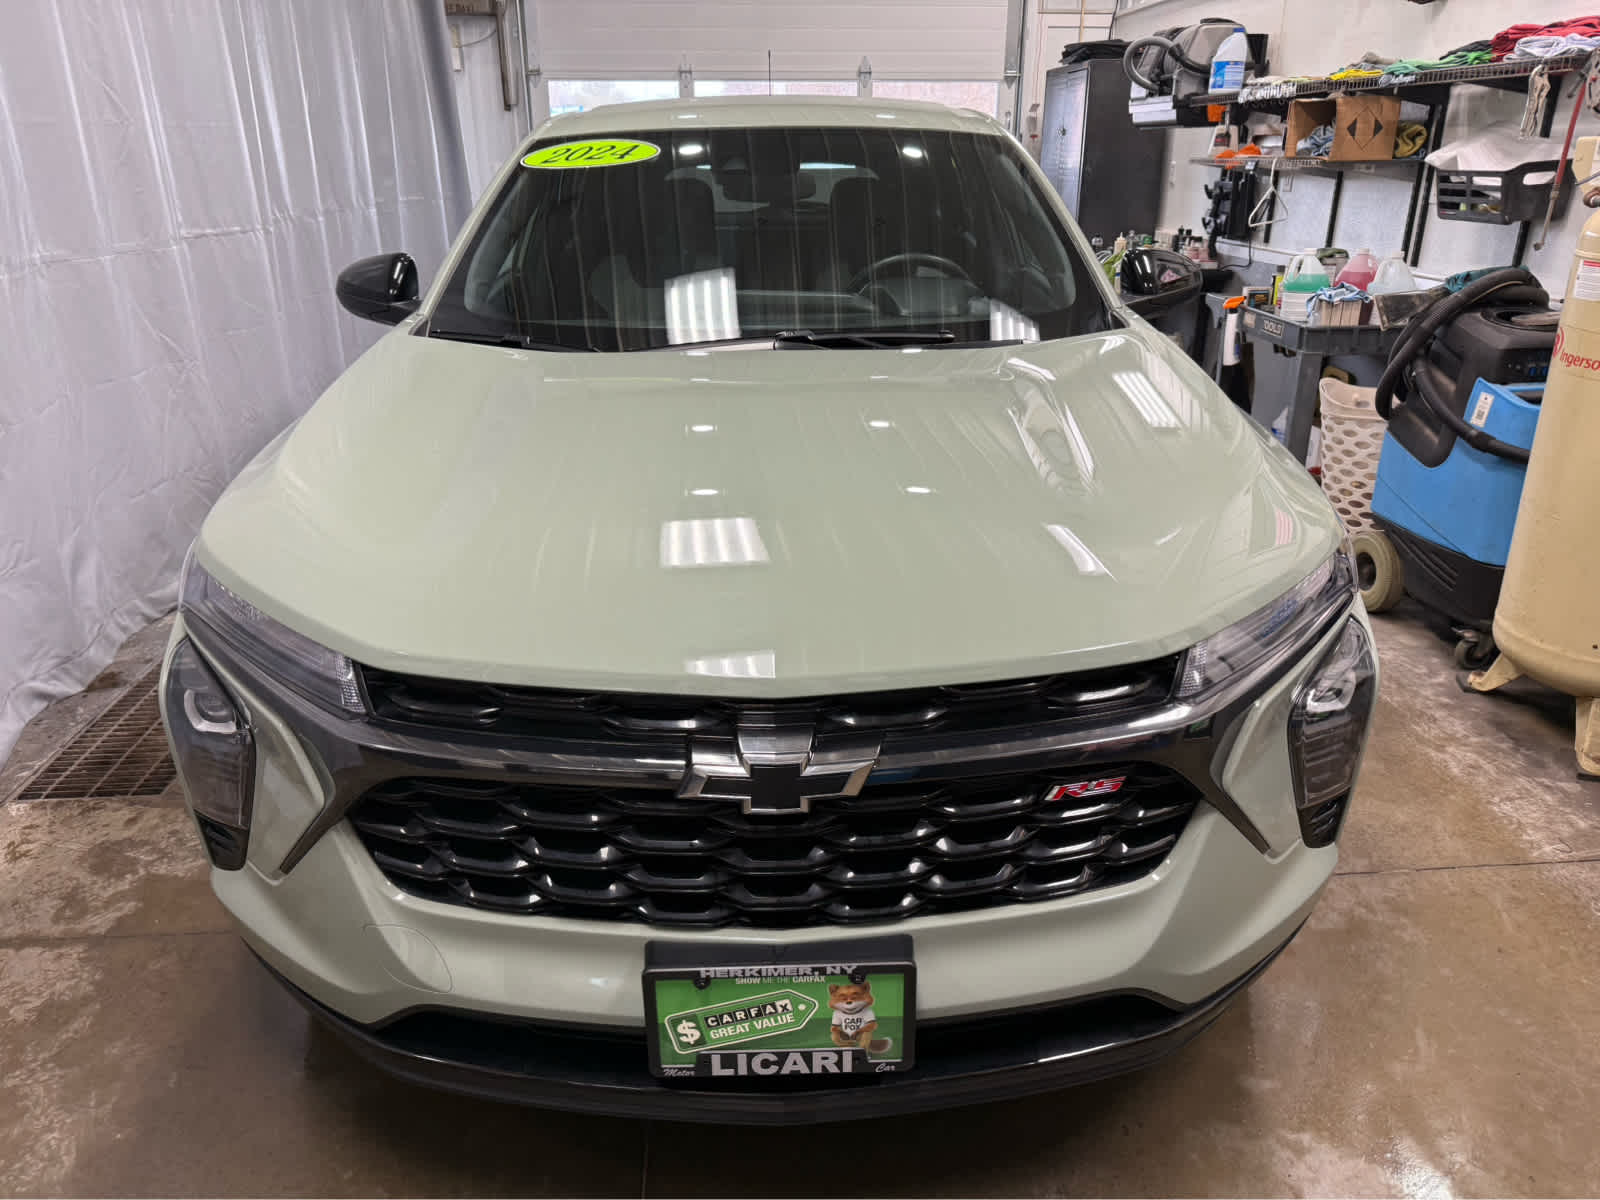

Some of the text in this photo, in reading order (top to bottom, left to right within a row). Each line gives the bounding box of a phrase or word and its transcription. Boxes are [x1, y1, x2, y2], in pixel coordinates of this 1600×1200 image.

[541, 144, 640, 164] 2024
[1044, 776, 1126, 801] RS
[792, 975, 826, 983] CARFAX
[826, 965, 857, 975] NY
[705, 999, 793, 1027] CARFAX
[710, 1013, 795, 1040] GREAT VALUE
[663, 1068, 695, 1077] Motor
[711, 1051, 853, 1076] LICARI
[875, 1063, 896, 1073] Car
